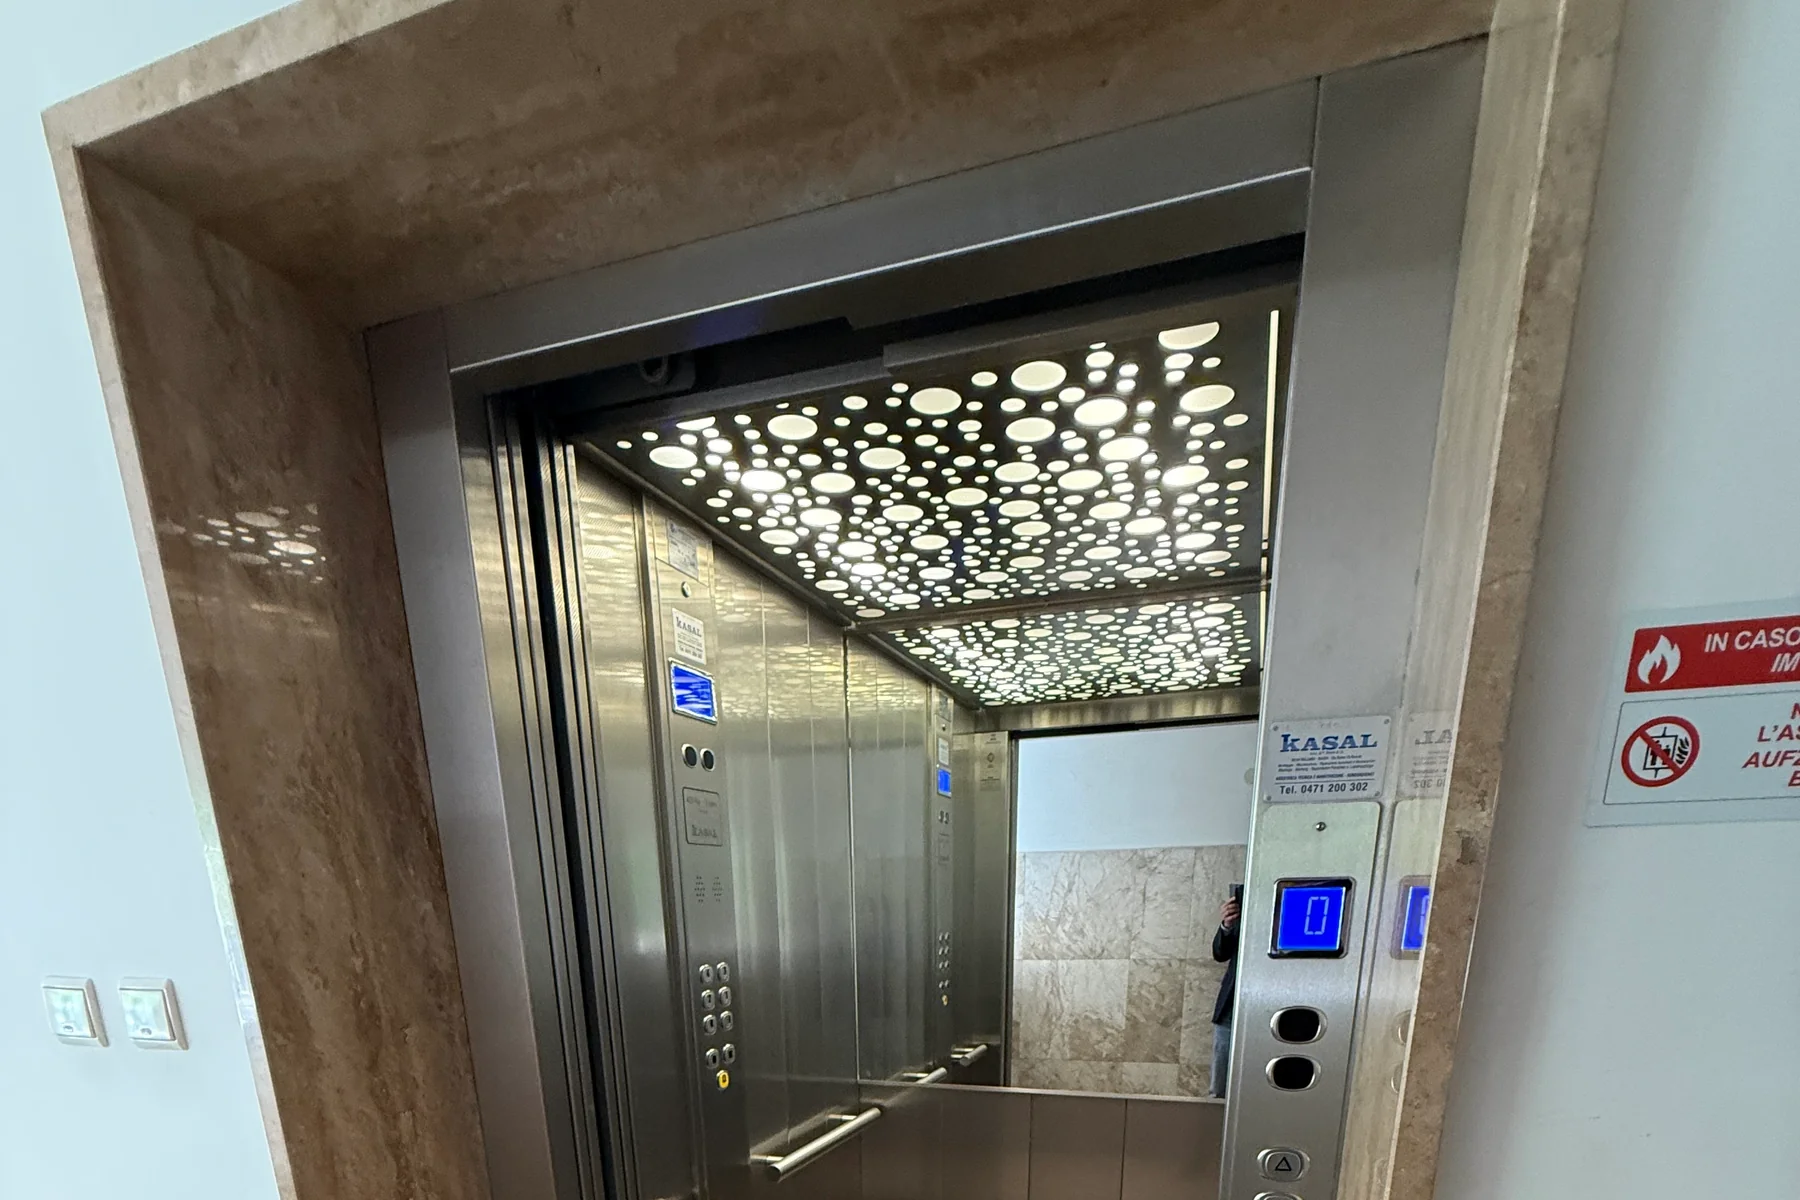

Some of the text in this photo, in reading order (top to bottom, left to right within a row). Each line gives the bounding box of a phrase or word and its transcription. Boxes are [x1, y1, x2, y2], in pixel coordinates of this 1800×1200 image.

[1704, 626, 1800, 652] IN CASO
[1770, 652, 1800, 672] IM
[1279, 781, 1368, 794] Tel. 0471 200 302
[1304, 896, 1330, 935] 0
